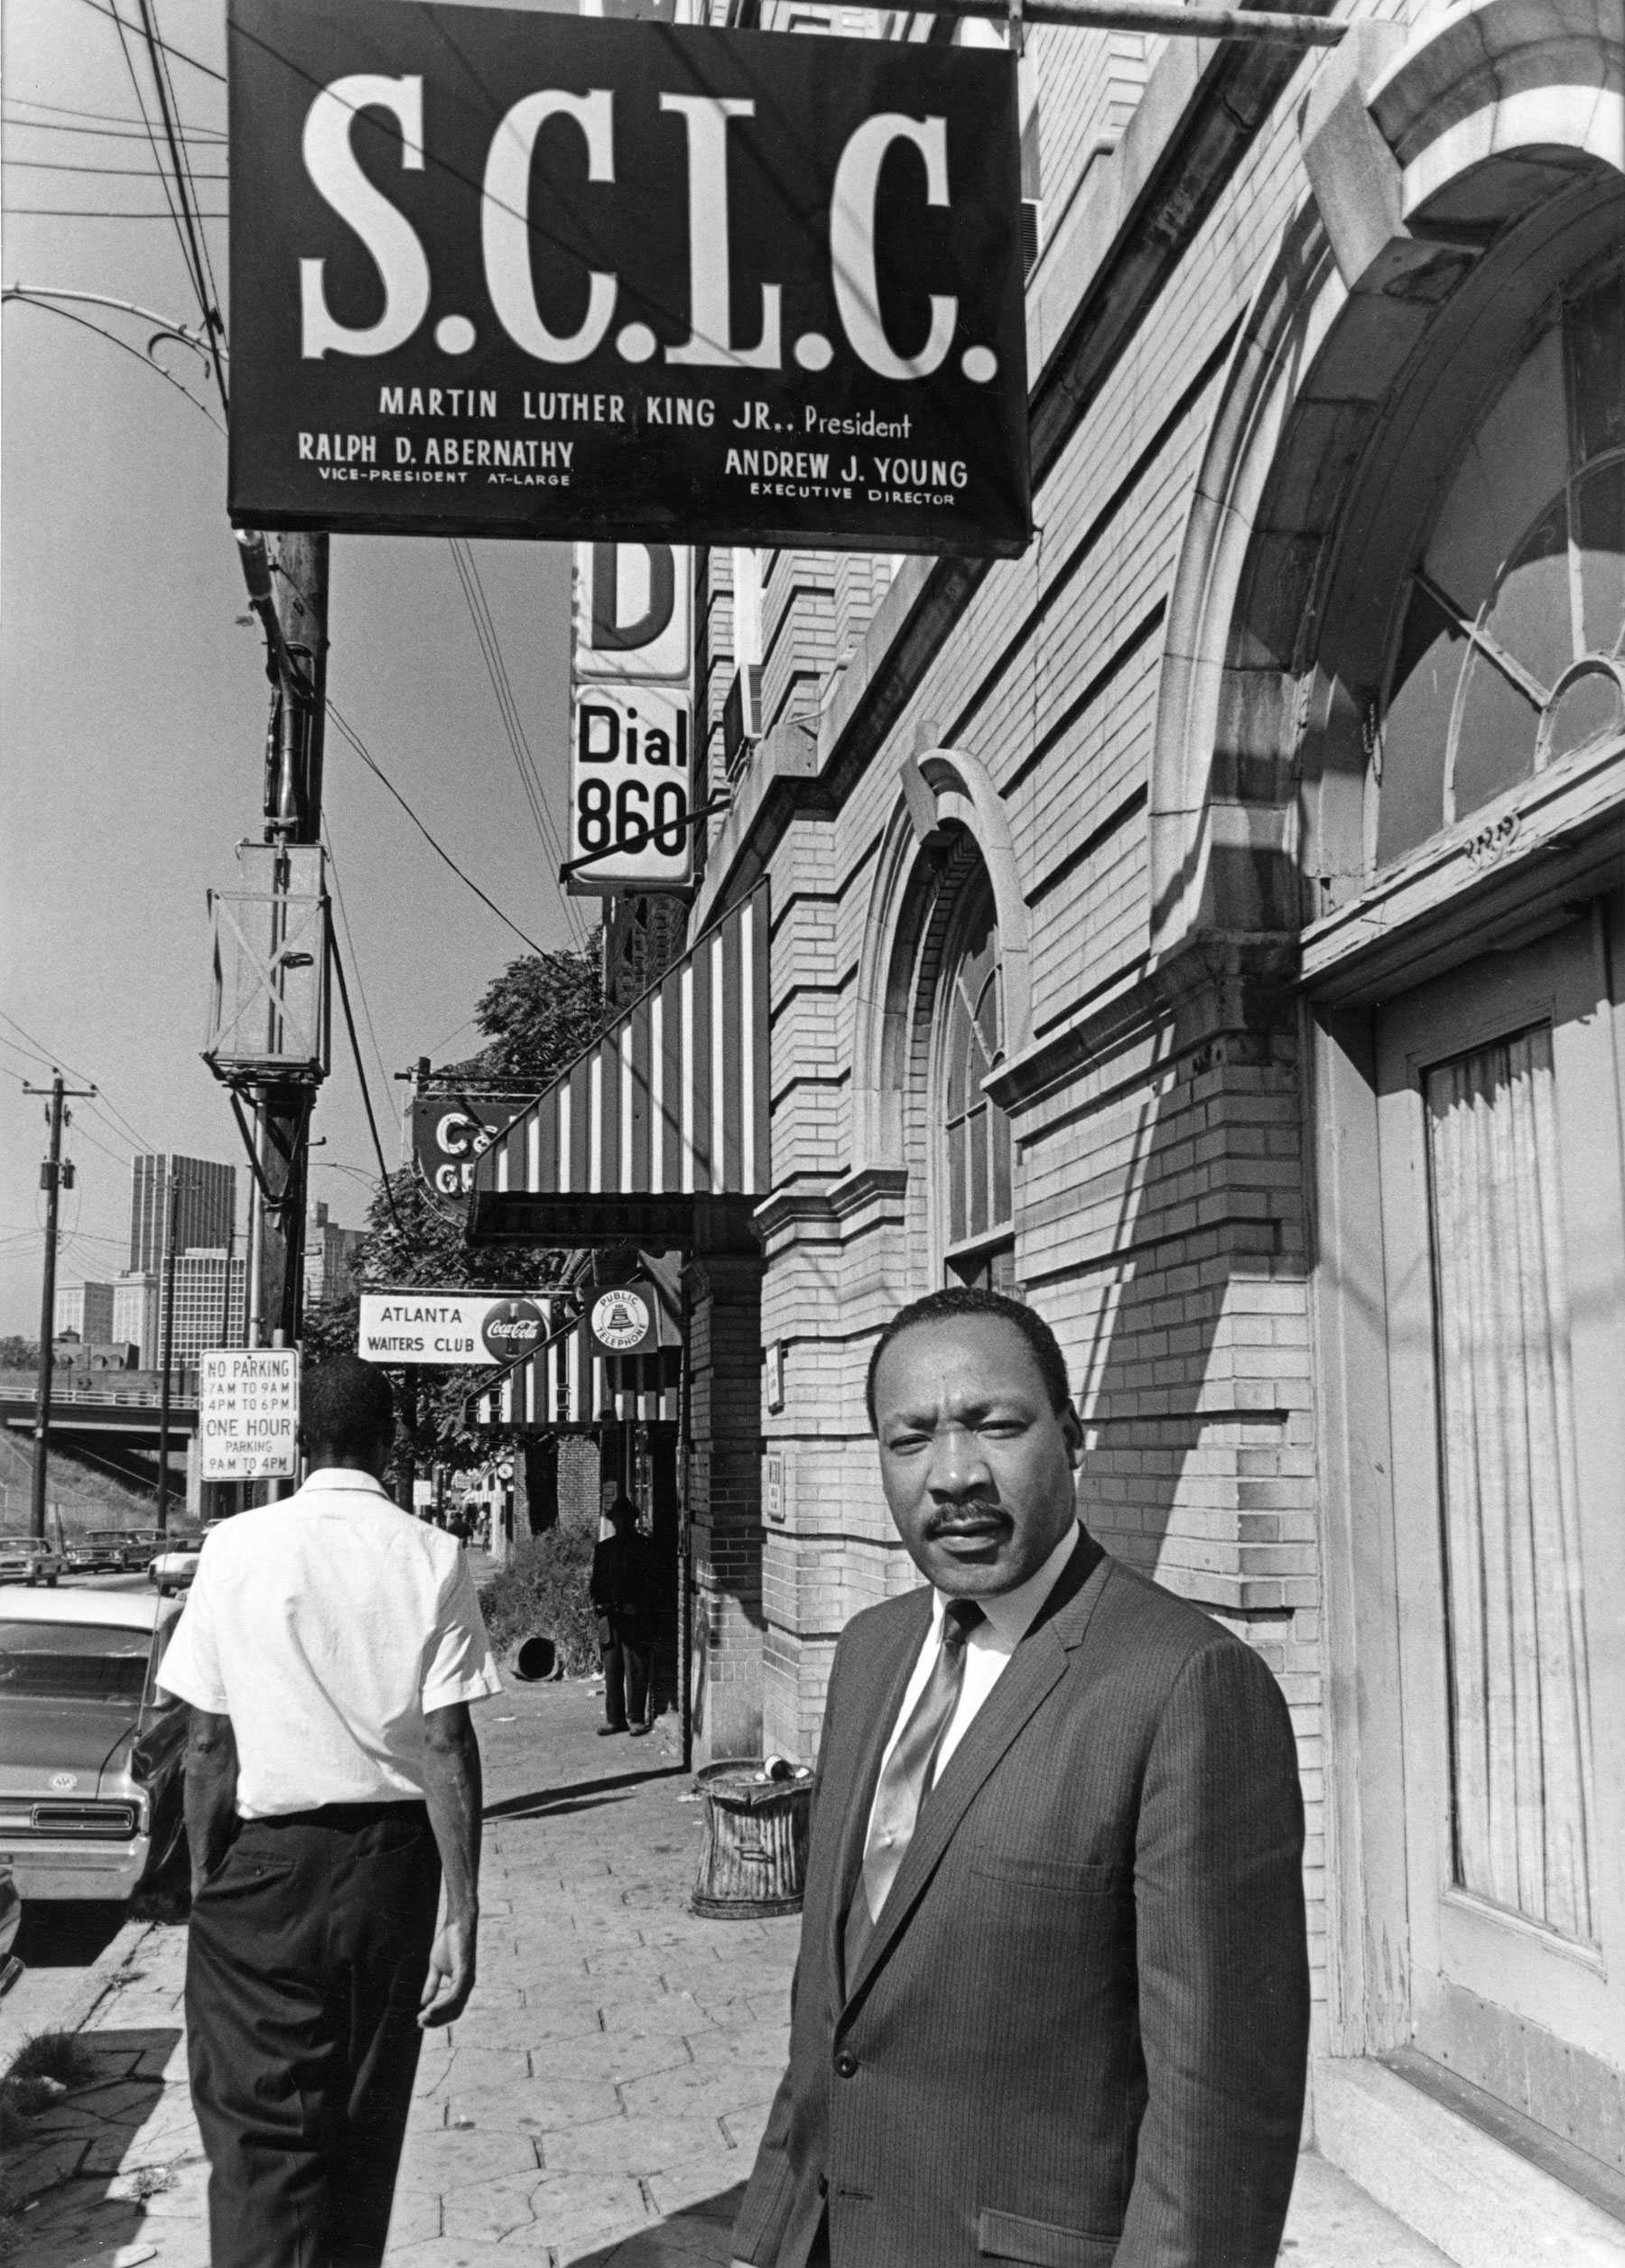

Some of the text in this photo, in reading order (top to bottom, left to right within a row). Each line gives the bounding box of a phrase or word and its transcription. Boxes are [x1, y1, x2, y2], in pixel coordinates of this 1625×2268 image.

[300, 74, 998, 383] S.C.L.C.
[379, 386, 497, 417] MARTIN
[524, 391, 625, 423] LUTHER
[646, 396, 715, 427] KING
[805, 405, 912, 438] President
[298, 432, 574, 468] RALPH D. ABERNATHY
[319, 467, 570, 487] VICE-PRESIDENT AT-LARGE
[725, 449, 968, 488] ANDREW J. YOUNG
[750, 482, 955, 506] EXECUTIVE DIRECTOR
[579, 704, 687, 767] Dial
[577, 777, 687, 857] 860
[599, 1292, 639, 1307] PUBLIC
[380, 1306, 463, 1324] ATLANTA
[367, 1336, 476, 1352] WAITERS CLUB
[596, 1323, 647, 1347] TELEPHONE
[208, 1360, 290, 1379] NO PARKING
[242, 1382, 257, 1394] TO
[242, 1399, 257, 1410] TO
[206, 1418, 291, 1437] ONE HOUR
[226, 1440, 273, 1453] PARKING
[243, 1457, 257, 1470] TO
